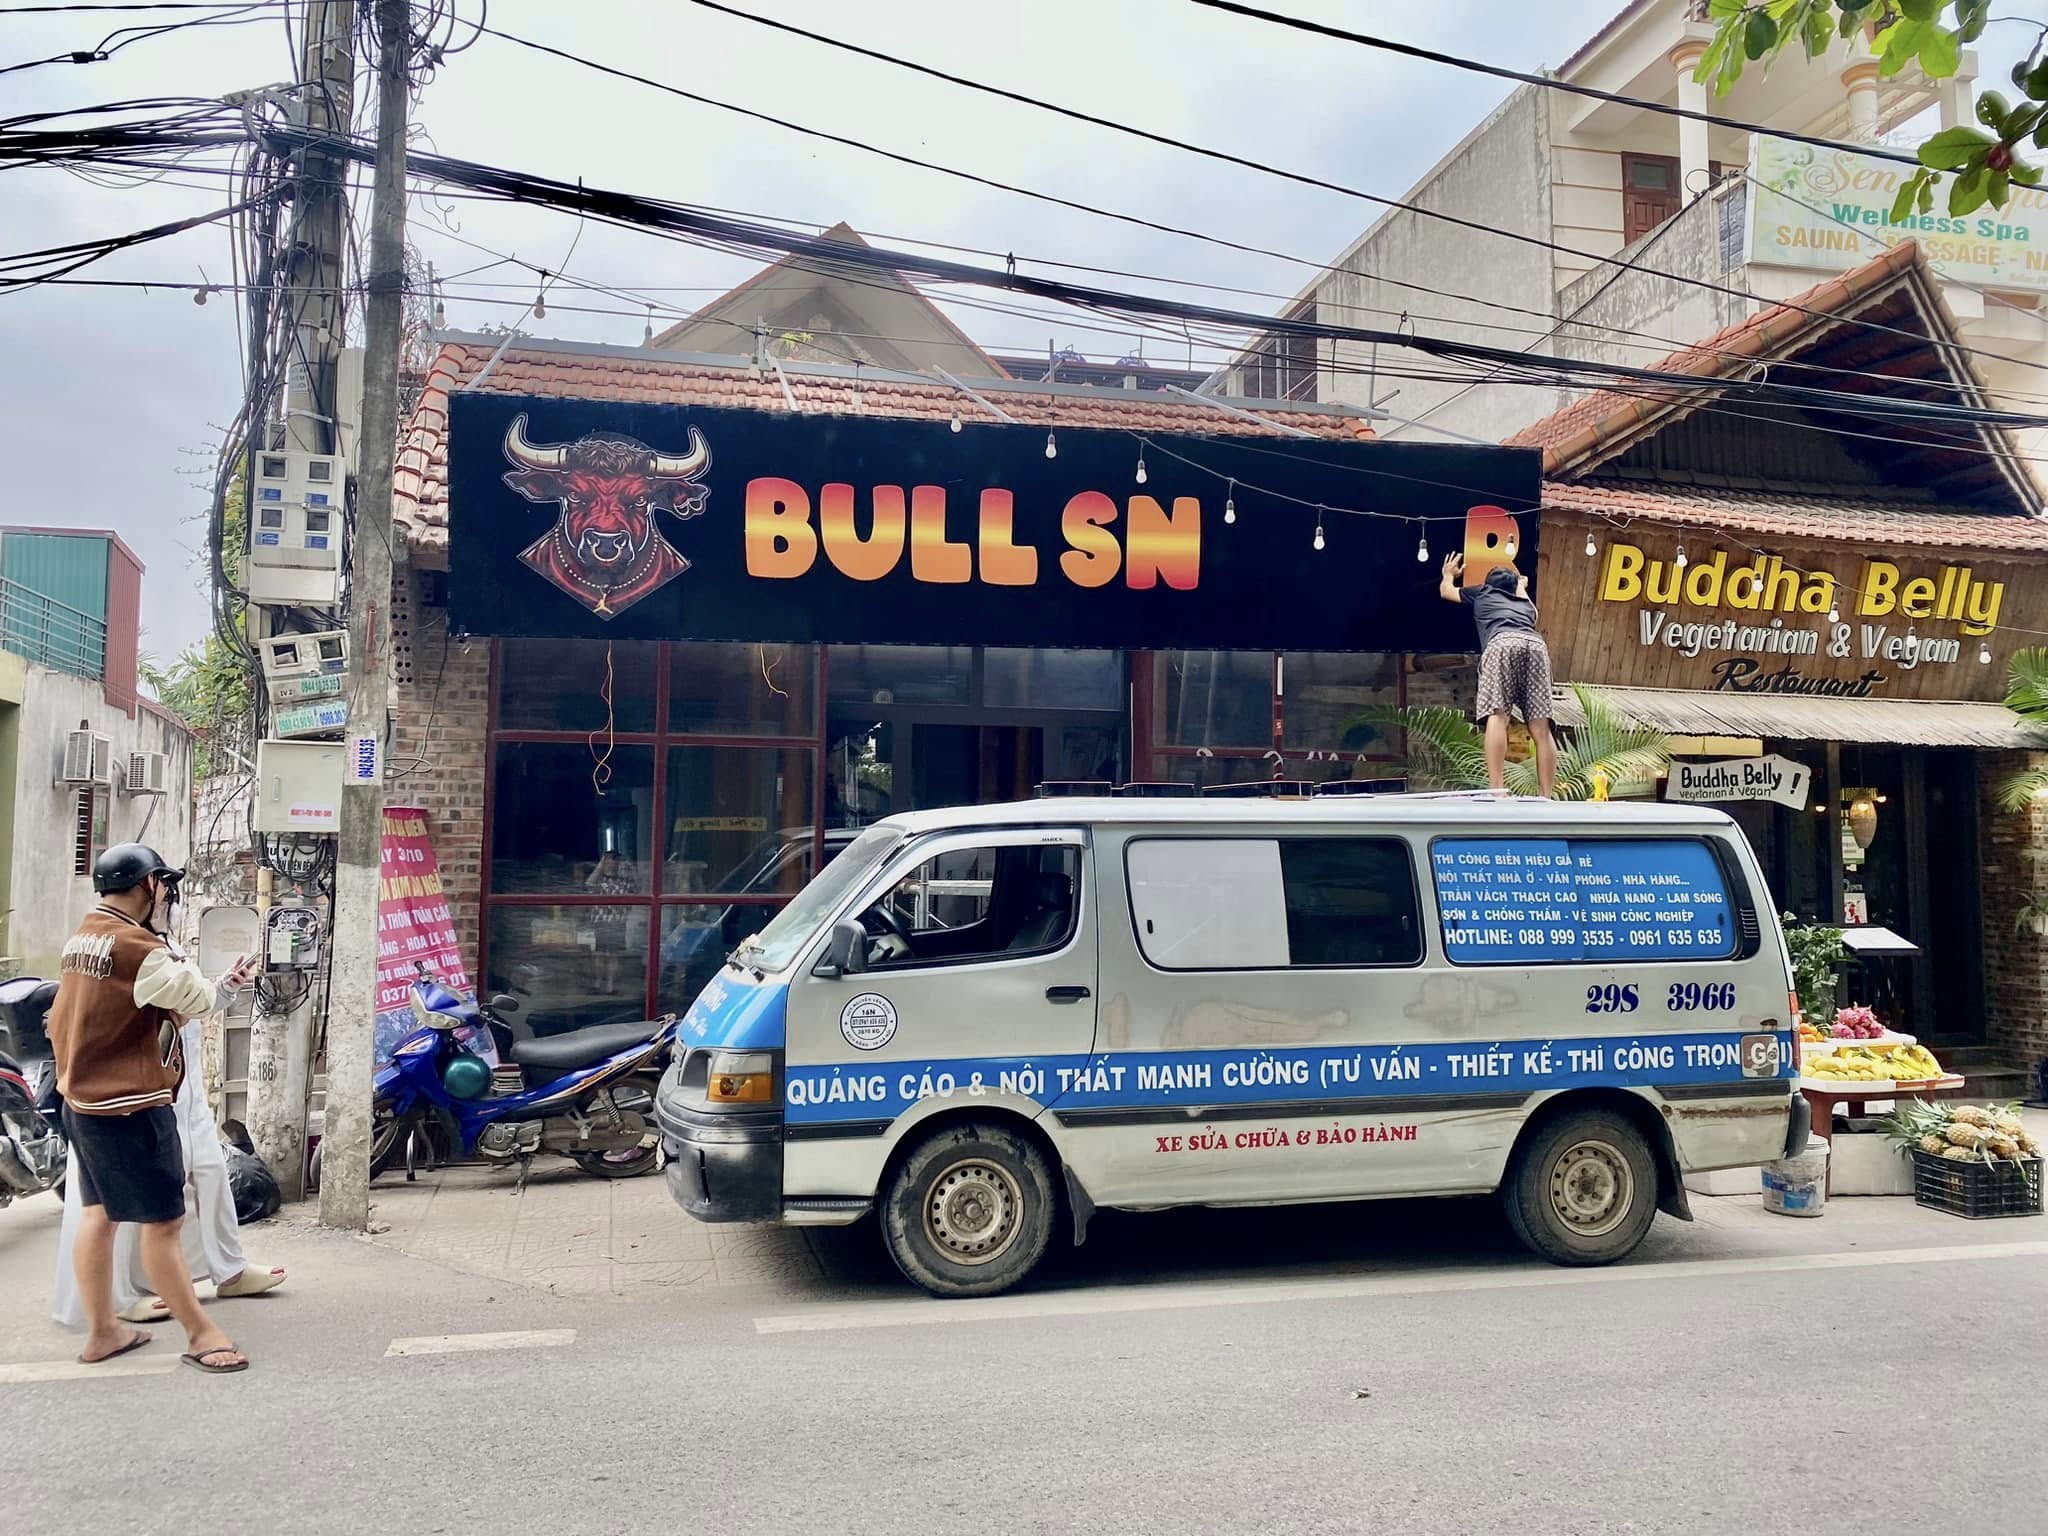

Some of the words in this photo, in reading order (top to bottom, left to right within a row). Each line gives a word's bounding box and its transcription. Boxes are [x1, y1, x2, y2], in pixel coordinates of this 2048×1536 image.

[1832, 203, 1966, 235] Welness
[1977, 217, 2029, 241] Spa
[1776, 226, 1860, 252] SAUNA
[745, 477, 1038, 586] BULL
[1059, 490, 1201, 591] SN
[1601, 542, 1837, 614] Buddha
[1856, 559, 2005, 637] Belly
[1638, 608, 1819, 658] Vegetarian
[1829, 623, 1852, 659] &
[1860, 624, 1961, 670] Vegan
[1711, 658, 1889, 698] Restaurant
[1681, 766, 1739, 789] Buddha
[1744, 763, 1782, 791] Belly
[1435, 854, 1454, 866] THI
[1458, 852, 1490, 866] CÔNG
[1462, 868, 1493, 884] THẤT
[1555, 891, 1578, 903] CAO
[1624, 892, 1655, 903] NANO
[1667, 892, 1690, 903] LAM
[1471, 909, 1480, 921] &
[1591, 910, 1617, 922] SINH
[406, 935, 428, 951] HOA
[1445, 929, 1513, 945] HOTLINE:
[1518, 929, 1545, 945] 088
[1550, 929, 1576, 945] 999
[1583, 930, 1615, 946] 3535
[1629, 930, 1662, 946] 0961
[1667, 929, 1693, 945] 635
[1697, 929, 1722, 945] 635
[1585, 983, 1640, 1014] 29S
[1667, 982, 1736, 1012] 3966
[786, 1067, 887, 1106] QUẢNG
[899, 1065, 956, 1100] CÁO
[967, 1071, 987, 1097] &
[1056, 1054, 1127, 1094] THẤT
[1137, 1063, 1211, 1095] MẠNH
[1222, 1051, 1310, 1087] CƯỜNG
[1319, 1053, 1362, 1089] (TƯ
[1370, 1046, 1421, 1081] VẤN
[1447, 1041, 1514, 1079] THIẾT
[1614, 1041, 1674, 1072] CÔNG
[1683, 1043, 1741, 1071] TRỌN
[1155, 1136, 1182, 1152] XE
[1188, 1125, 1228, 1151] SỬA
[1235, 1127, 1290, 1149] CHỮA
[1296, 1130, 1311, 1145] &
[1316, 1122, 1357, 1144] BẢO
[1362, 1123, 1418, 1142] HÀNH
